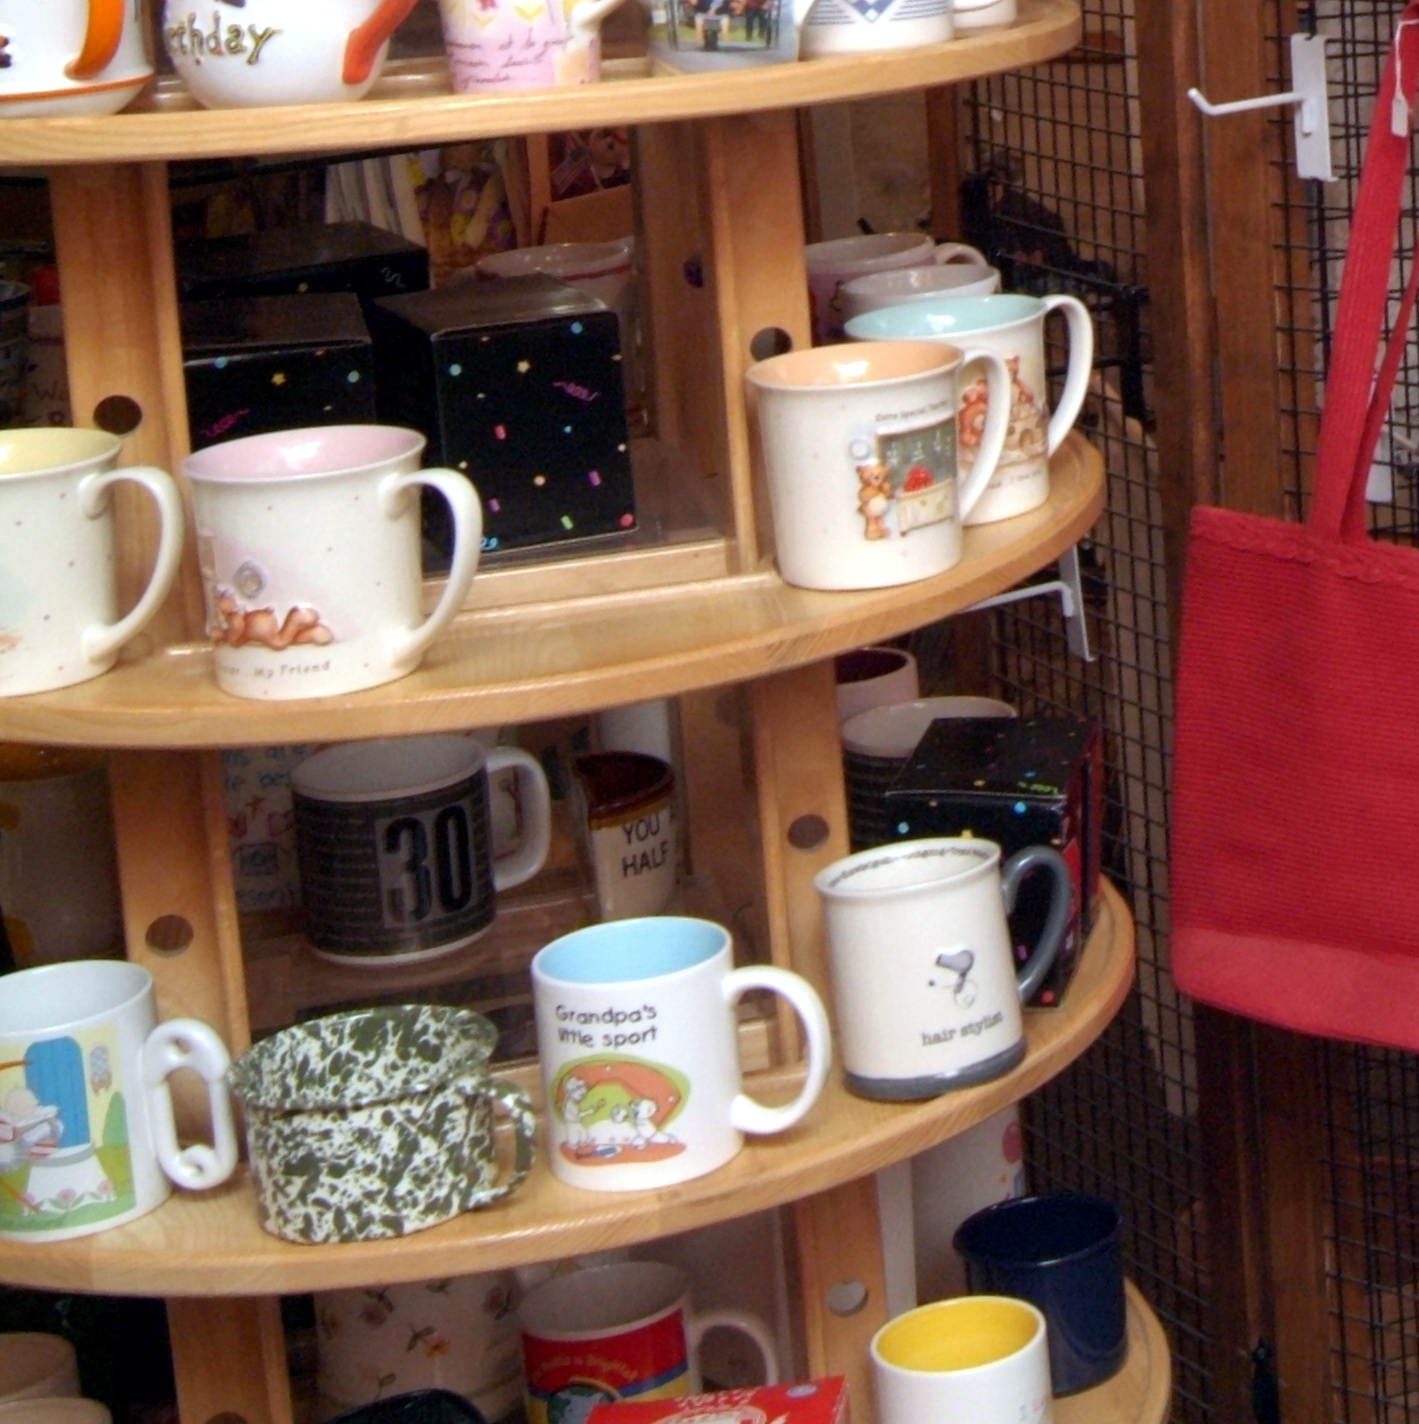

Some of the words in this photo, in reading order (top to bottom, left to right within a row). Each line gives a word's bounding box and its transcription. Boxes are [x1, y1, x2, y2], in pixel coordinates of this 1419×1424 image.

[621, 814, 661, 846] YOU
[380, 803, 477, 924] 30
[621, 840, 669, 878] HALF
[555, 1003, 658, 1027] Grandpa's
[920, 1029, 957, 1047] hair
[960, 1010, 1005, 1038] stylist
[557, 1028, 595, 1049] little
[602, 1025, 658, 1049] sport
